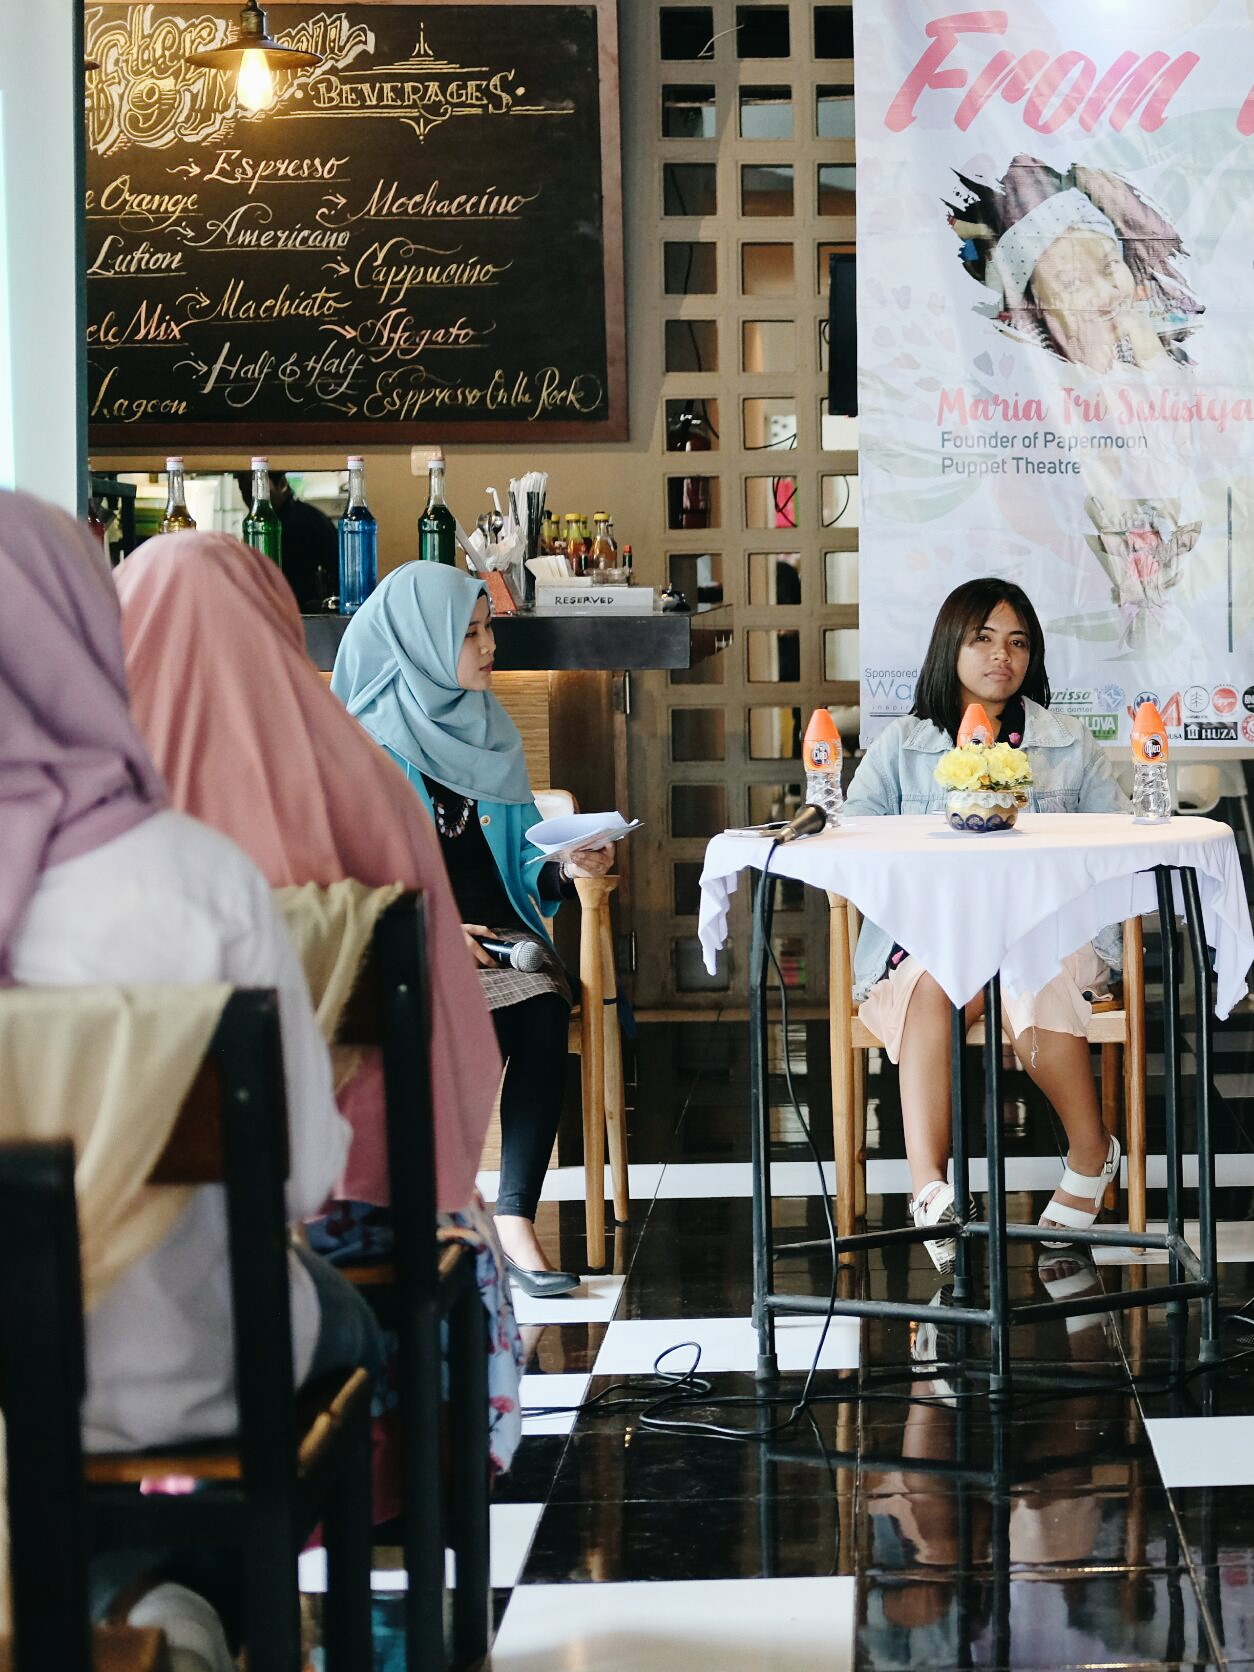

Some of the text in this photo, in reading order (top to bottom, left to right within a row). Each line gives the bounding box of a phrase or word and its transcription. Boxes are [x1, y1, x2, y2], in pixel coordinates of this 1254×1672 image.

[884, 10, 1201, 134] From
[308, 69, 515, 120] BEVERAGES
[203, 150, 350, 193] Espresso
[101, 175, 199, 222] Orange
[192, 203, 350, 248] Americano
[210, 278, 352, 319] Machiato
[118, 300, 190, 344] Mix
[937, 388, 1049, 427] Maria
[1060, 387, 1108, 425] Tri
[941, 431, 1149, 452] Founder of Papermoon
[941, 456, 1081, 477] Puppet Theatre
[554, 596, 614, 605] RESERVED
[865, 667, 918, 679] Sponsored
[1201, 728, 1238, 739] HUZA
